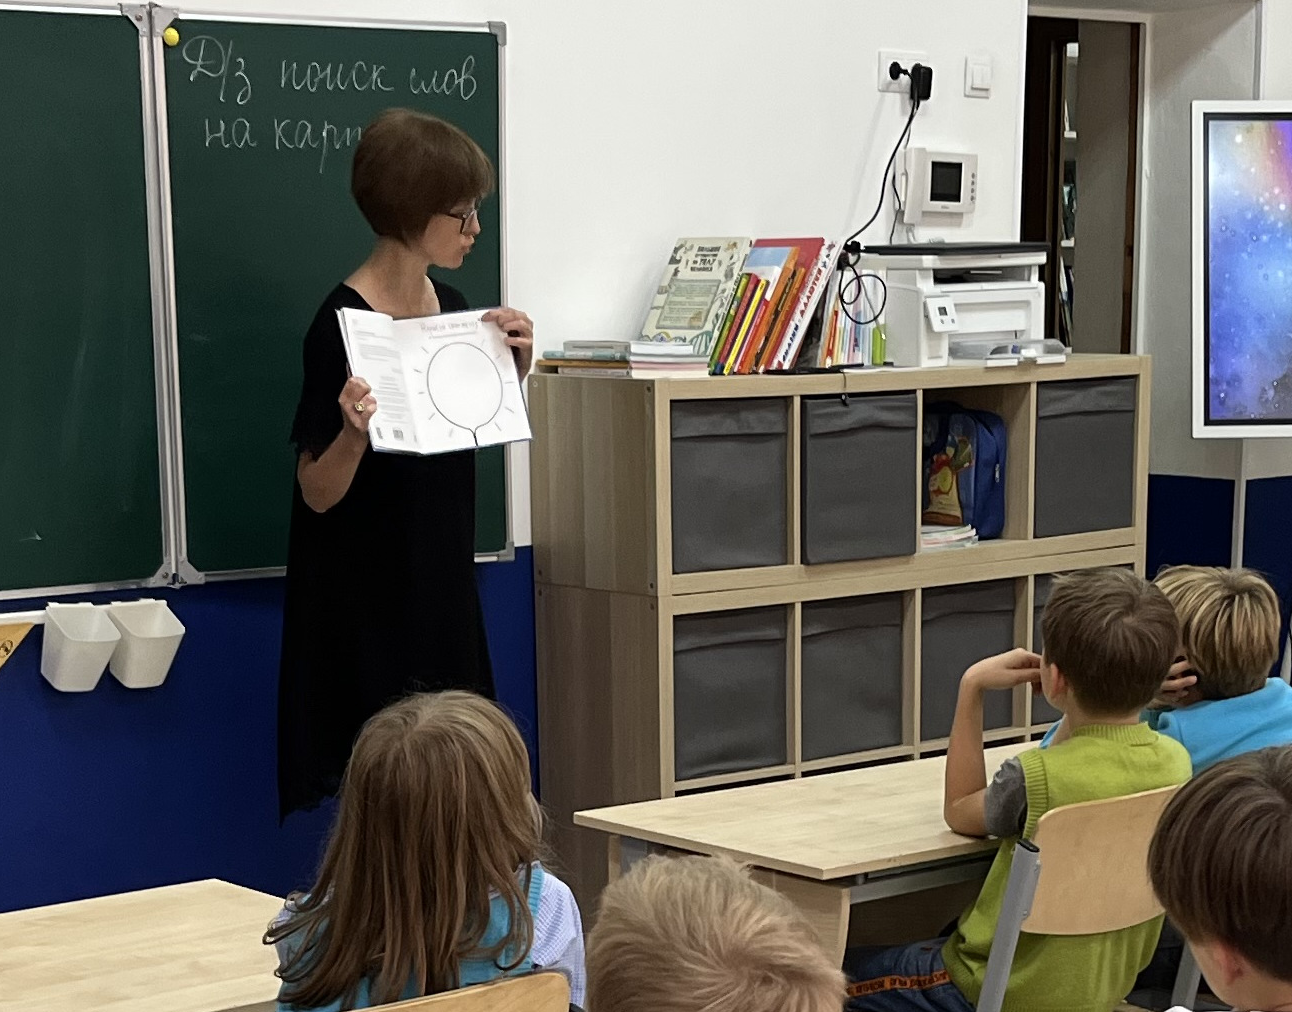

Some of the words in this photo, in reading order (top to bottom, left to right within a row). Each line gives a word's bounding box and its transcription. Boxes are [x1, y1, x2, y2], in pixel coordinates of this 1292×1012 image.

[280, 59, 394, 93] поиск
[409, 54, 478, 101] слов
[205, 117, 257, 149] на
